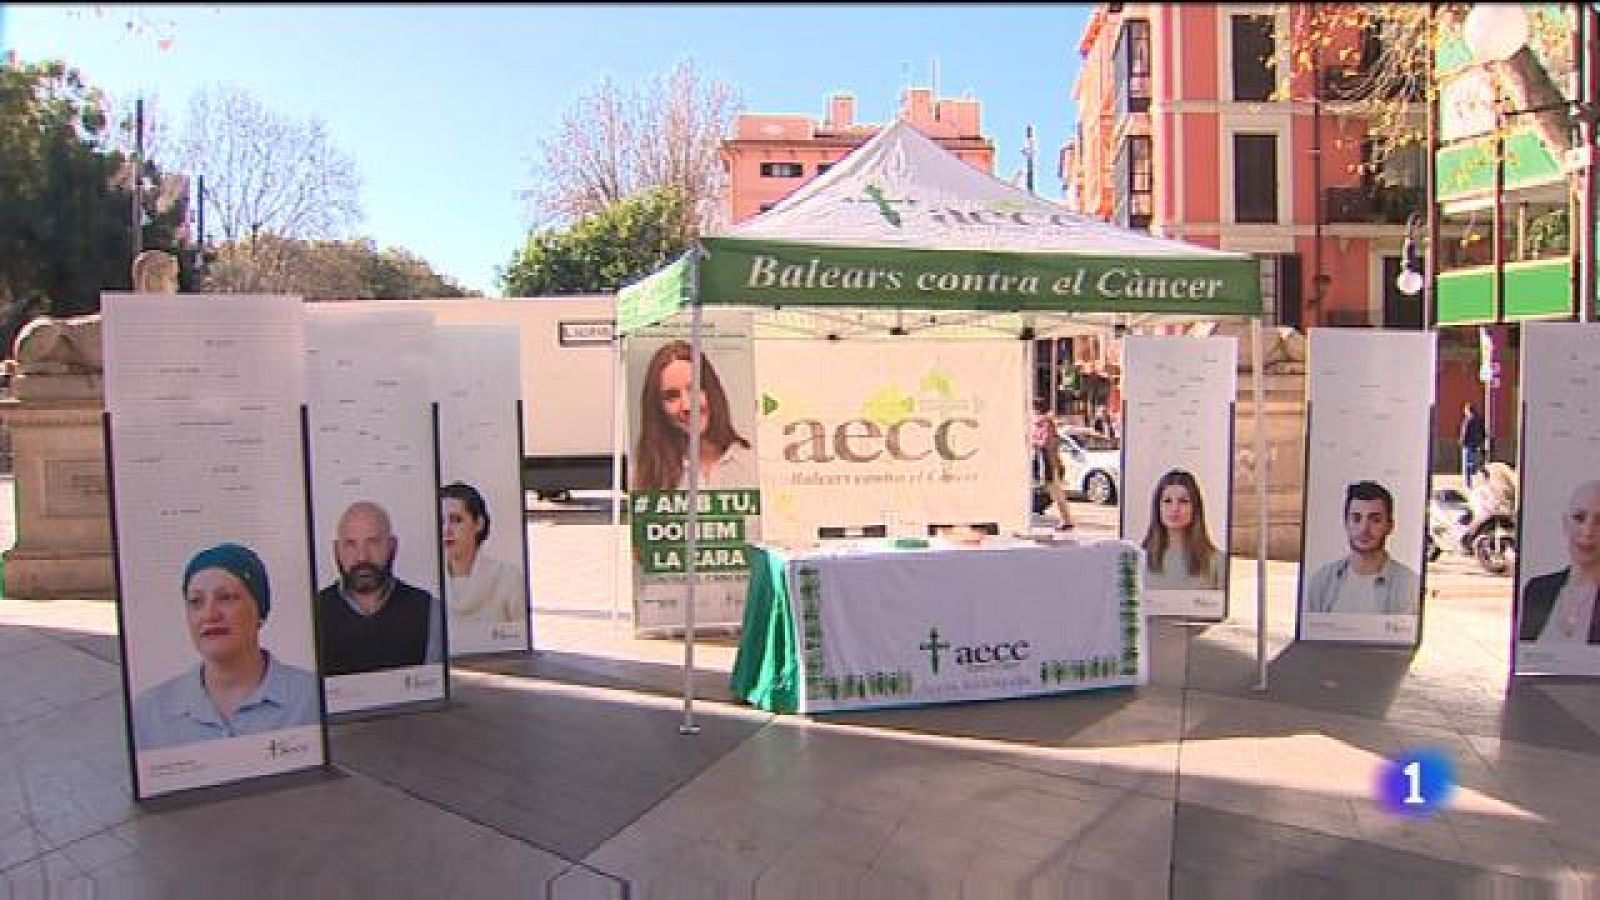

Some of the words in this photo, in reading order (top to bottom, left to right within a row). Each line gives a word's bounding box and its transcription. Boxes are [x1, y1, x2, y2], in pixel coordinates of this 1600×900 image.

[746, 255, 904, 289] Balears
[916, 270, 1039, 295] contra
[1052, 267, 1087, 296] el
[783, 417, 979, 463] aecc
[654, 551, 680, 568] LA
[954, 639, 1031, 665] aecc
